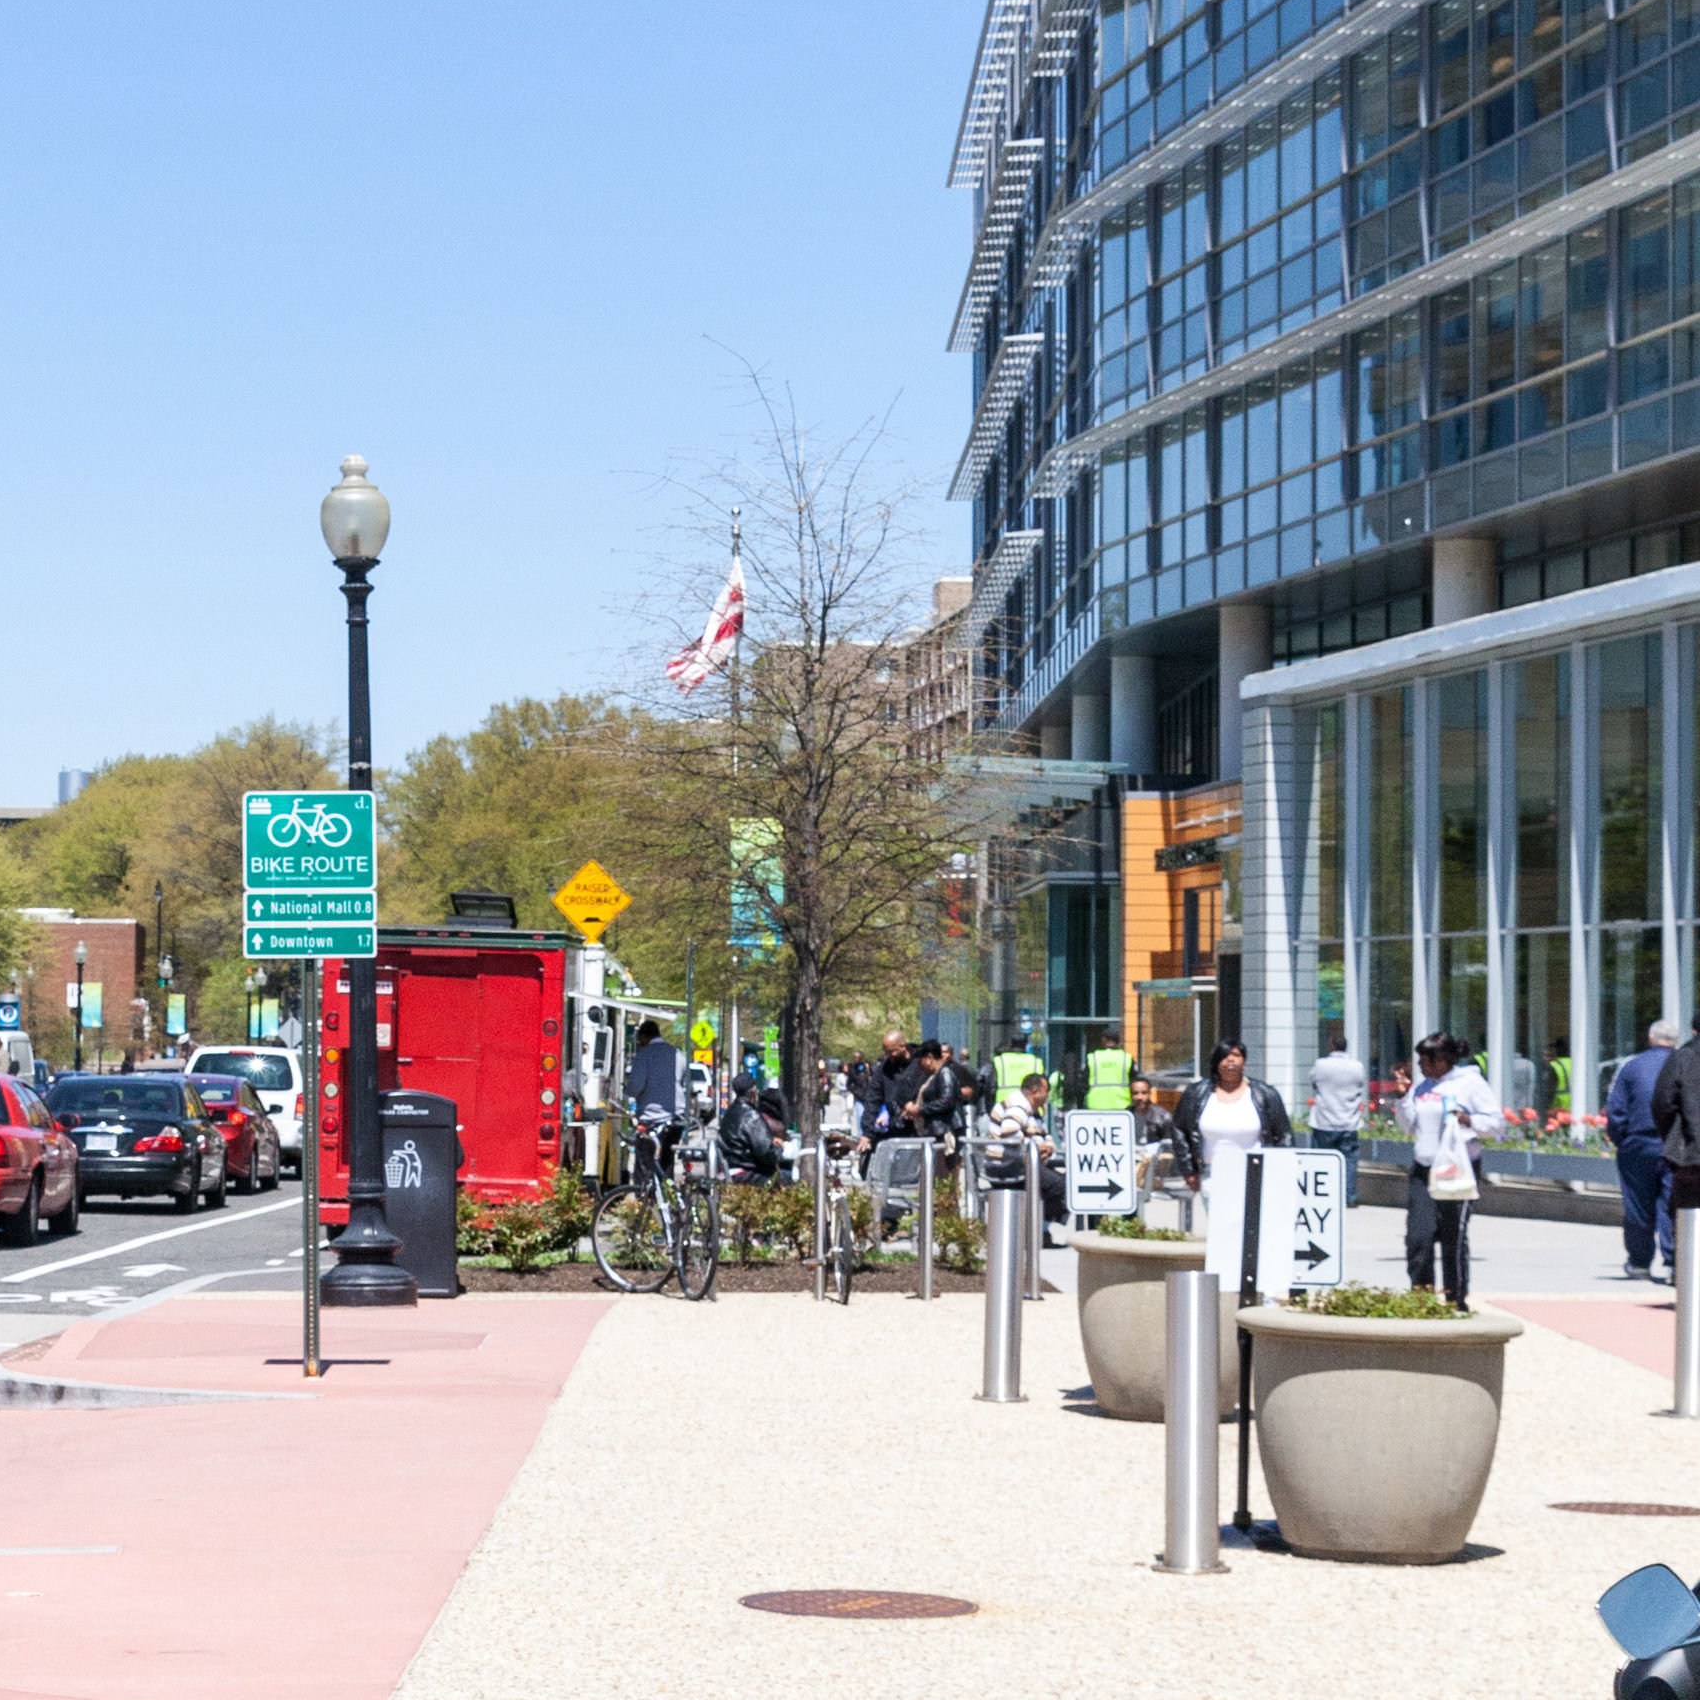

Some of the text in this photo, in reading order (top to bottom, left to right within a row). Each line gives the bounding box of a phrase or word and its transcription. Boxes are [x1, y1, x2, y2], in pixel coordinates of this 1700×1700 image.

[251, 856, 368, 873] BIKE ROUTE
[575, 884, 609, 892] RAISED
[271, 901, 372, 914] National Mall 0.8
[270, 935, 371, 948] Downtown 1.7
[1075, 1126, 1123, 1146] ONE
[1077, 1154, 1124, 1173] WAY
[1296, 1171, 1329, 1197] NE
[1295, 1208, 1331, 1233] AY
